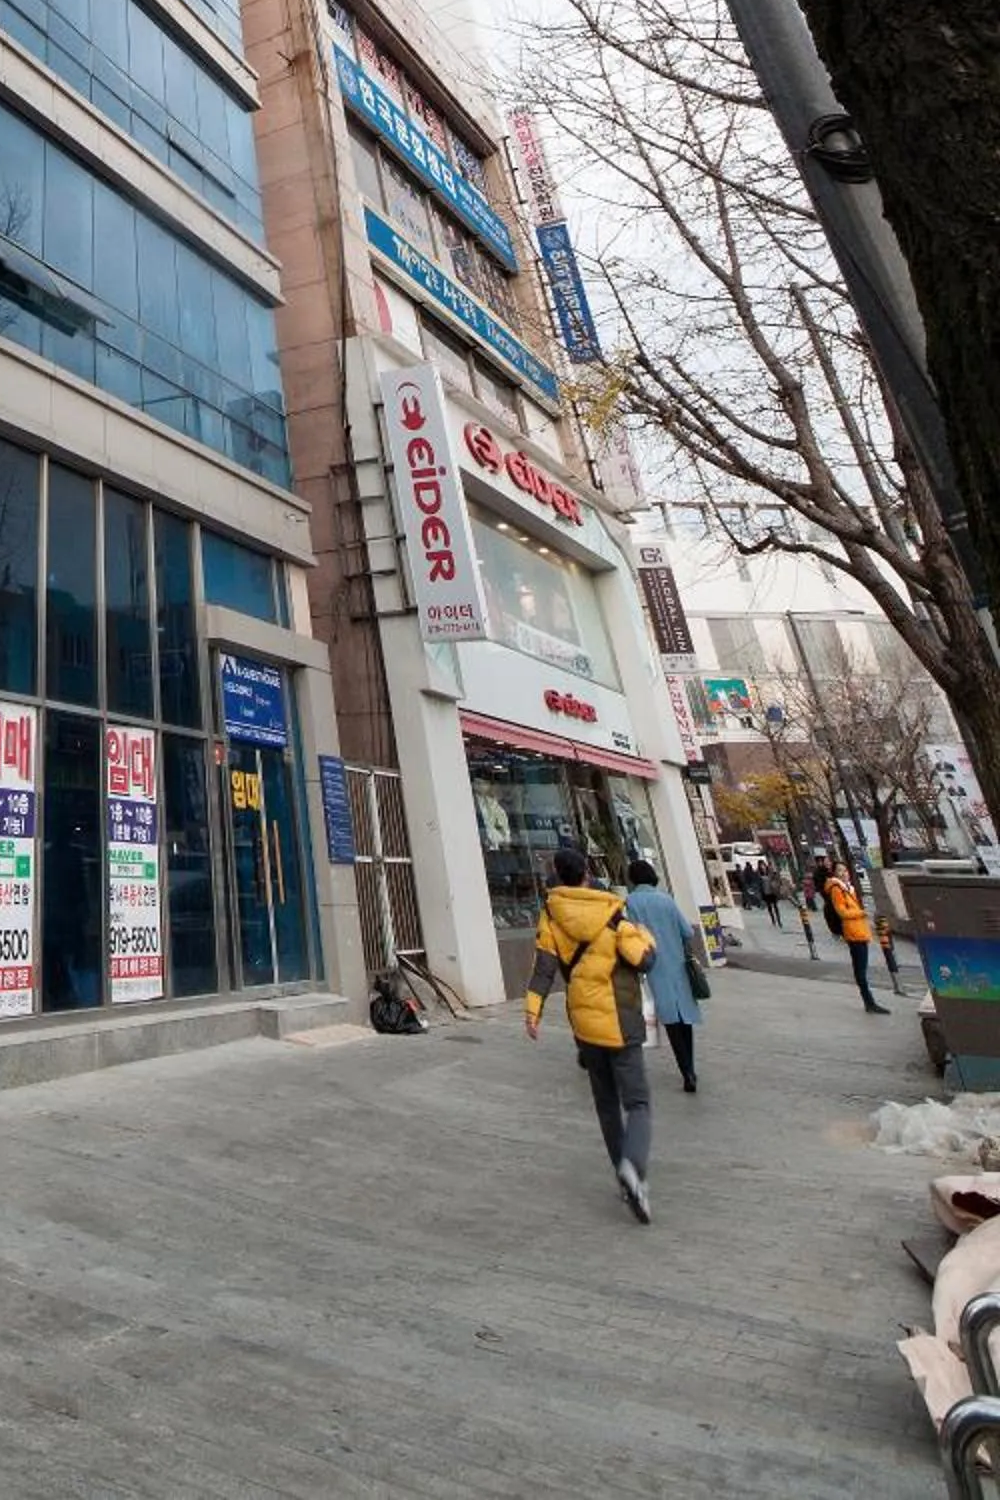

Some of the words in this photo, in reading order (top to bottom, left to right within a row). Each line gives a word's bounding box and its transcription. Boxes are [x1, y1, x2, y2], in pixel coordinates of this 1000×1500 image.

[427, 603, 473, 620] 아이더
[107, 730, 154, 800] 임대
[231, 770, 261, 811] 임대
[108, 849, 143, 862] NAVER
